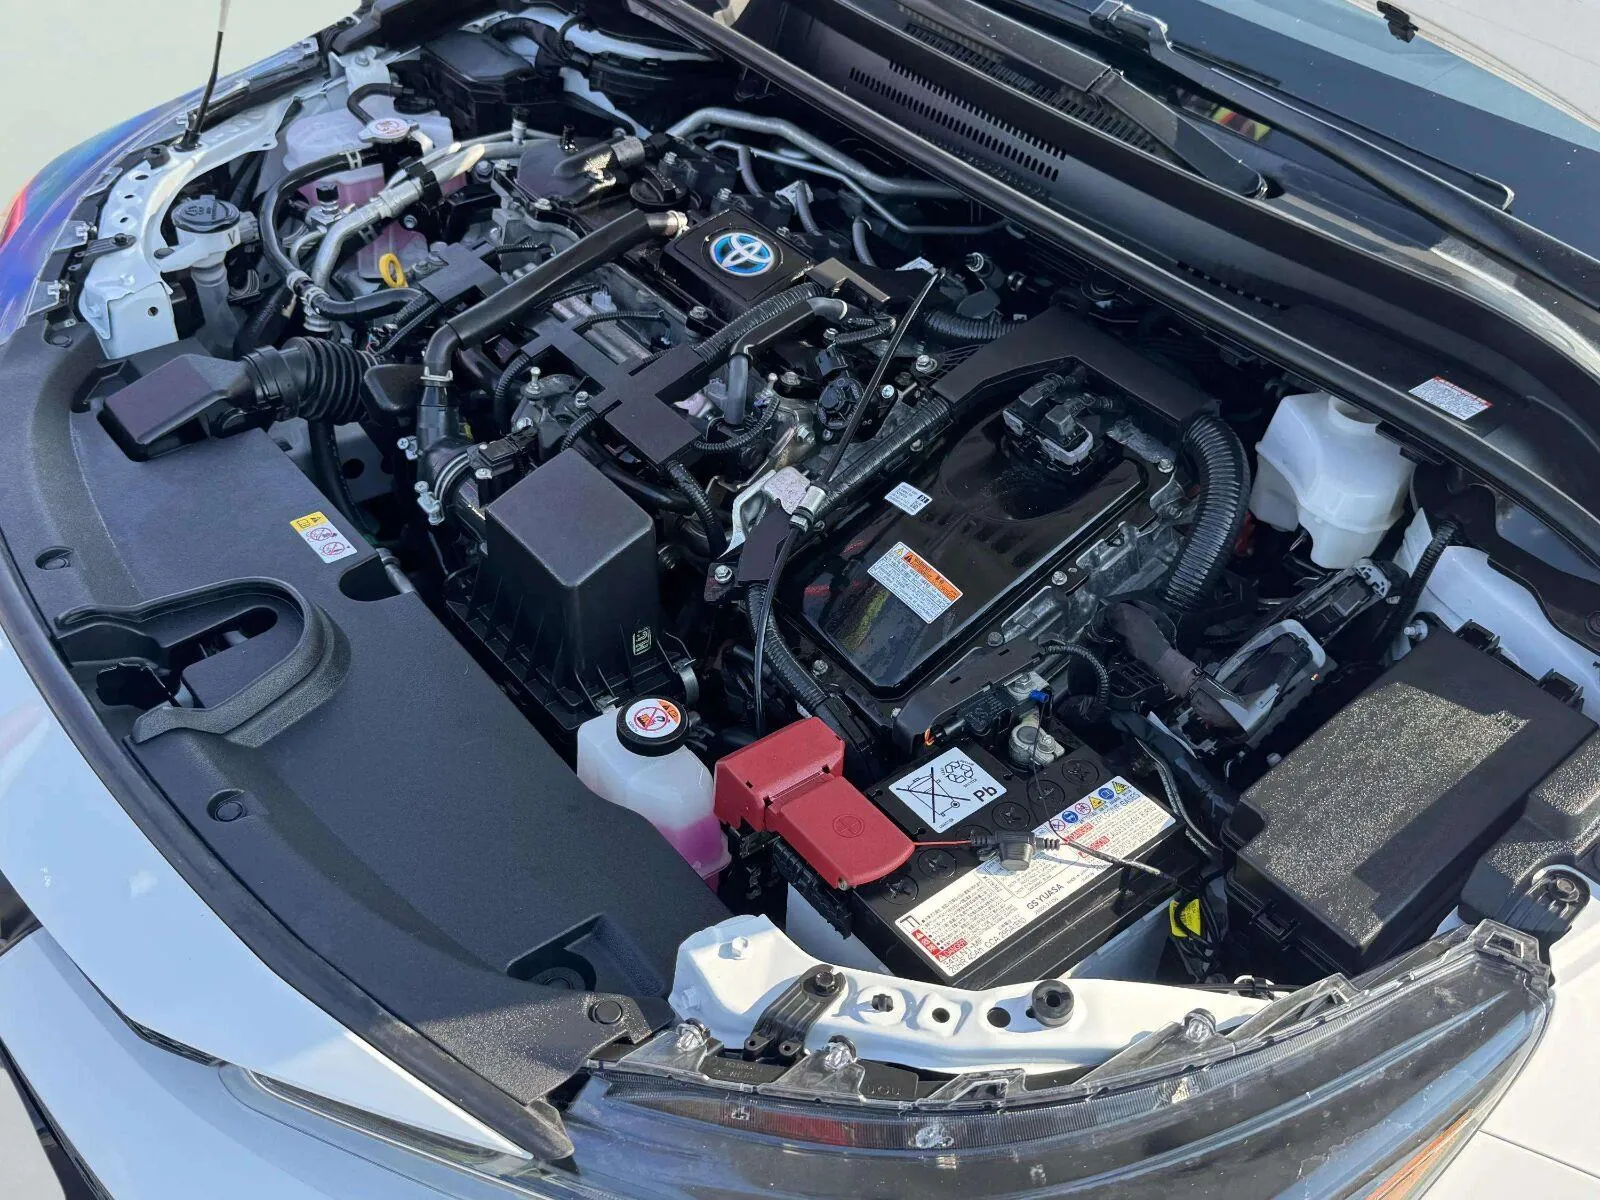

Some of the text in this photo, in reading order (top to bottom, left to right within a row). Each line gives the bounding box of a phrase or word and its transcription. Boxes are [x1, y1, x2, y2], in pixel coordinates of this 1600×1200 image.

[973, 786, 998, 802] Pb
[1036, 883, 1064, 902] YUASA
[942, 940, 966, 956] DANGER
